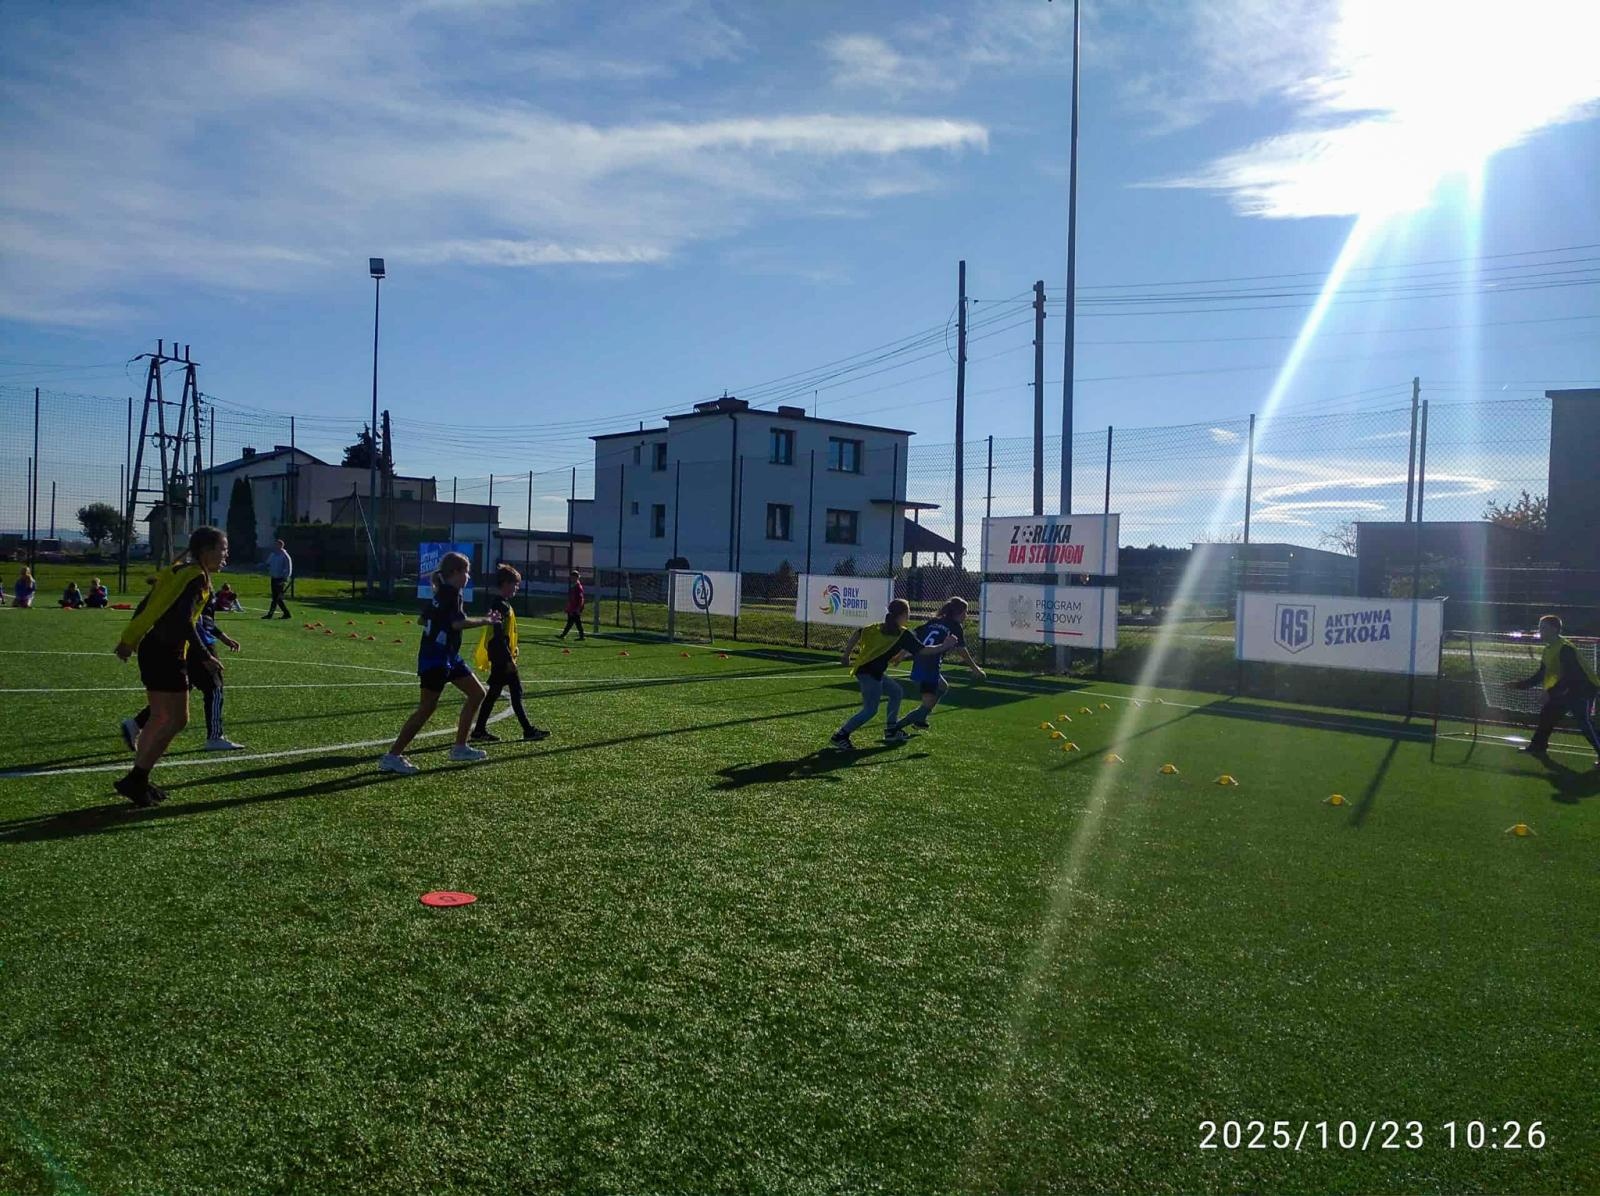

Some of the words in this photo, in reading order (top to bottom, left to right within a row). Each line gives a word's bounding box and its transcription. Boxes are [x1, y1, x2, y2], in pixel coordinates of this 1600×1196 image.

[1008, 545, 1027, 564] NA
[1029, 544, 1084, 565] STADION
[842, 598, 868, 610] SPORTU
[1035, 600, 1082, 611] PROGRAM
[1325, 608, 1392, 629] AKTYWNA
[1324, 623, 1391, 646] SZKOŁA
